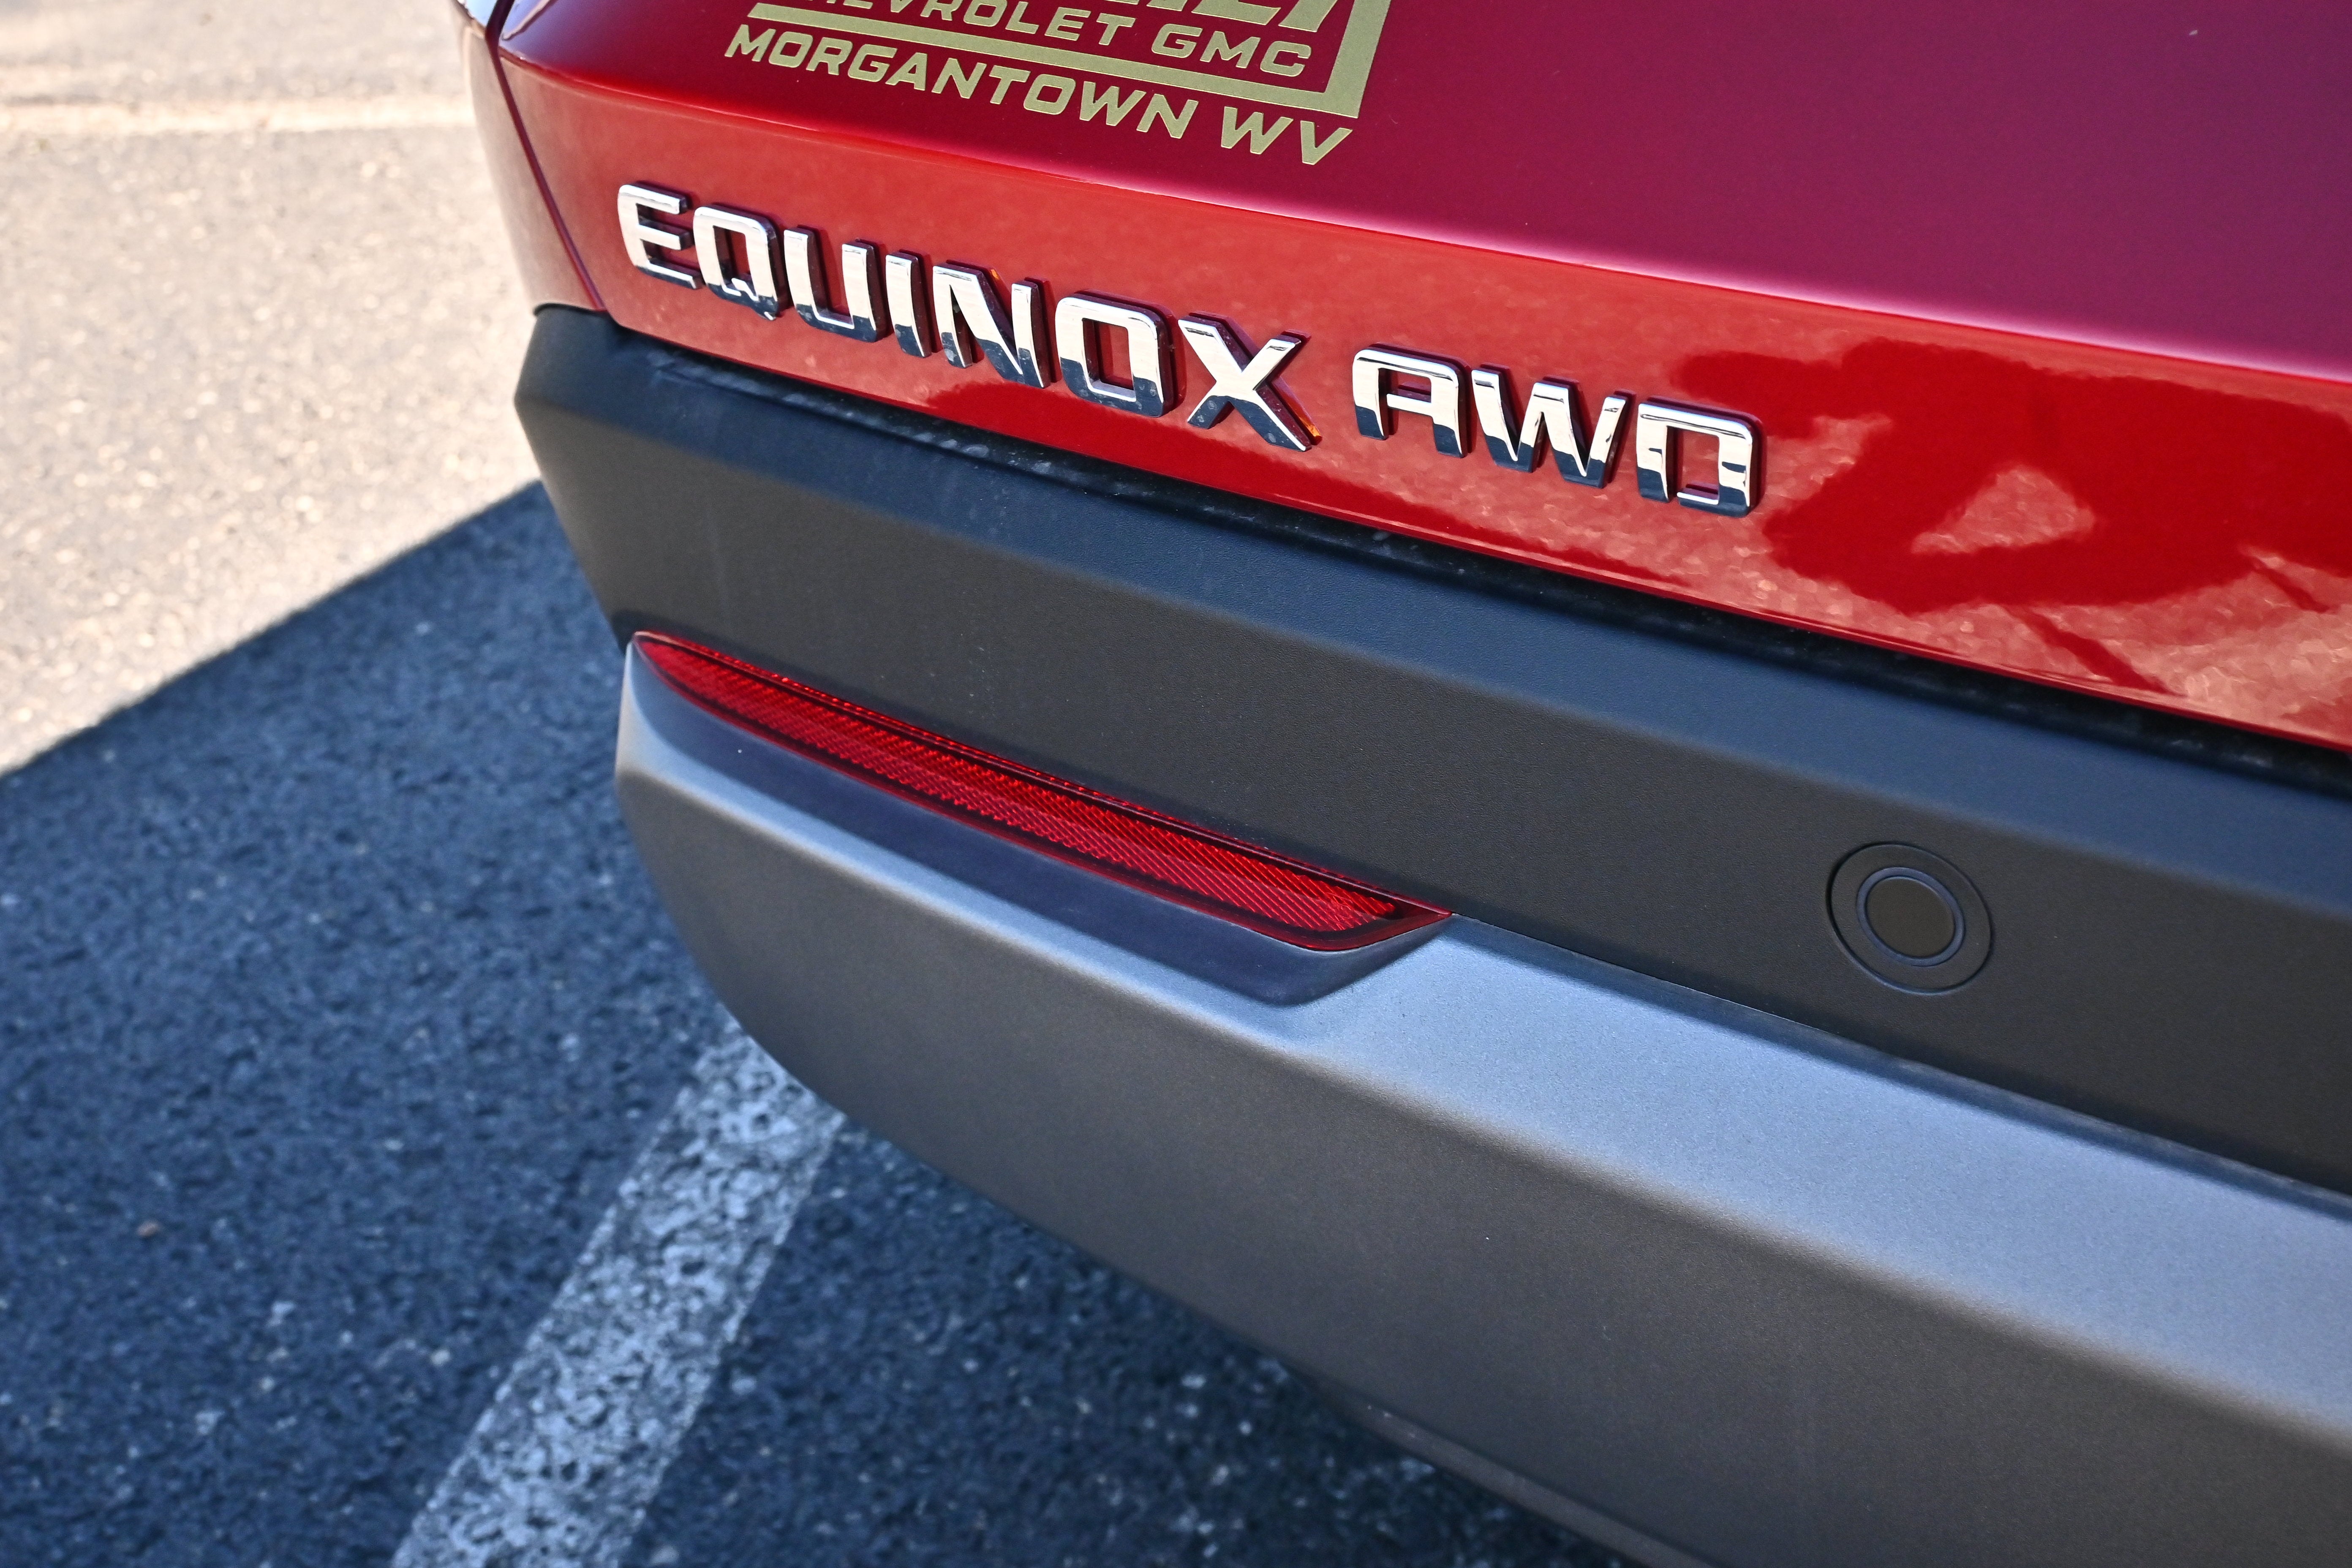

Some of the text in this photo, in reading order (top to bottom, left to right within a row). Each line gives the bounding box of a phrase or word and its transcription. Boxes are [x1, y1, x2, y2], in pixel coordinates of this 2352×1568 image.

[724, 24, 1353, 166] MORGANTOWN WV
[1151, 24, 1312, 77] GMC
[616, 182, 1760, 517] EQUINOX AWD
